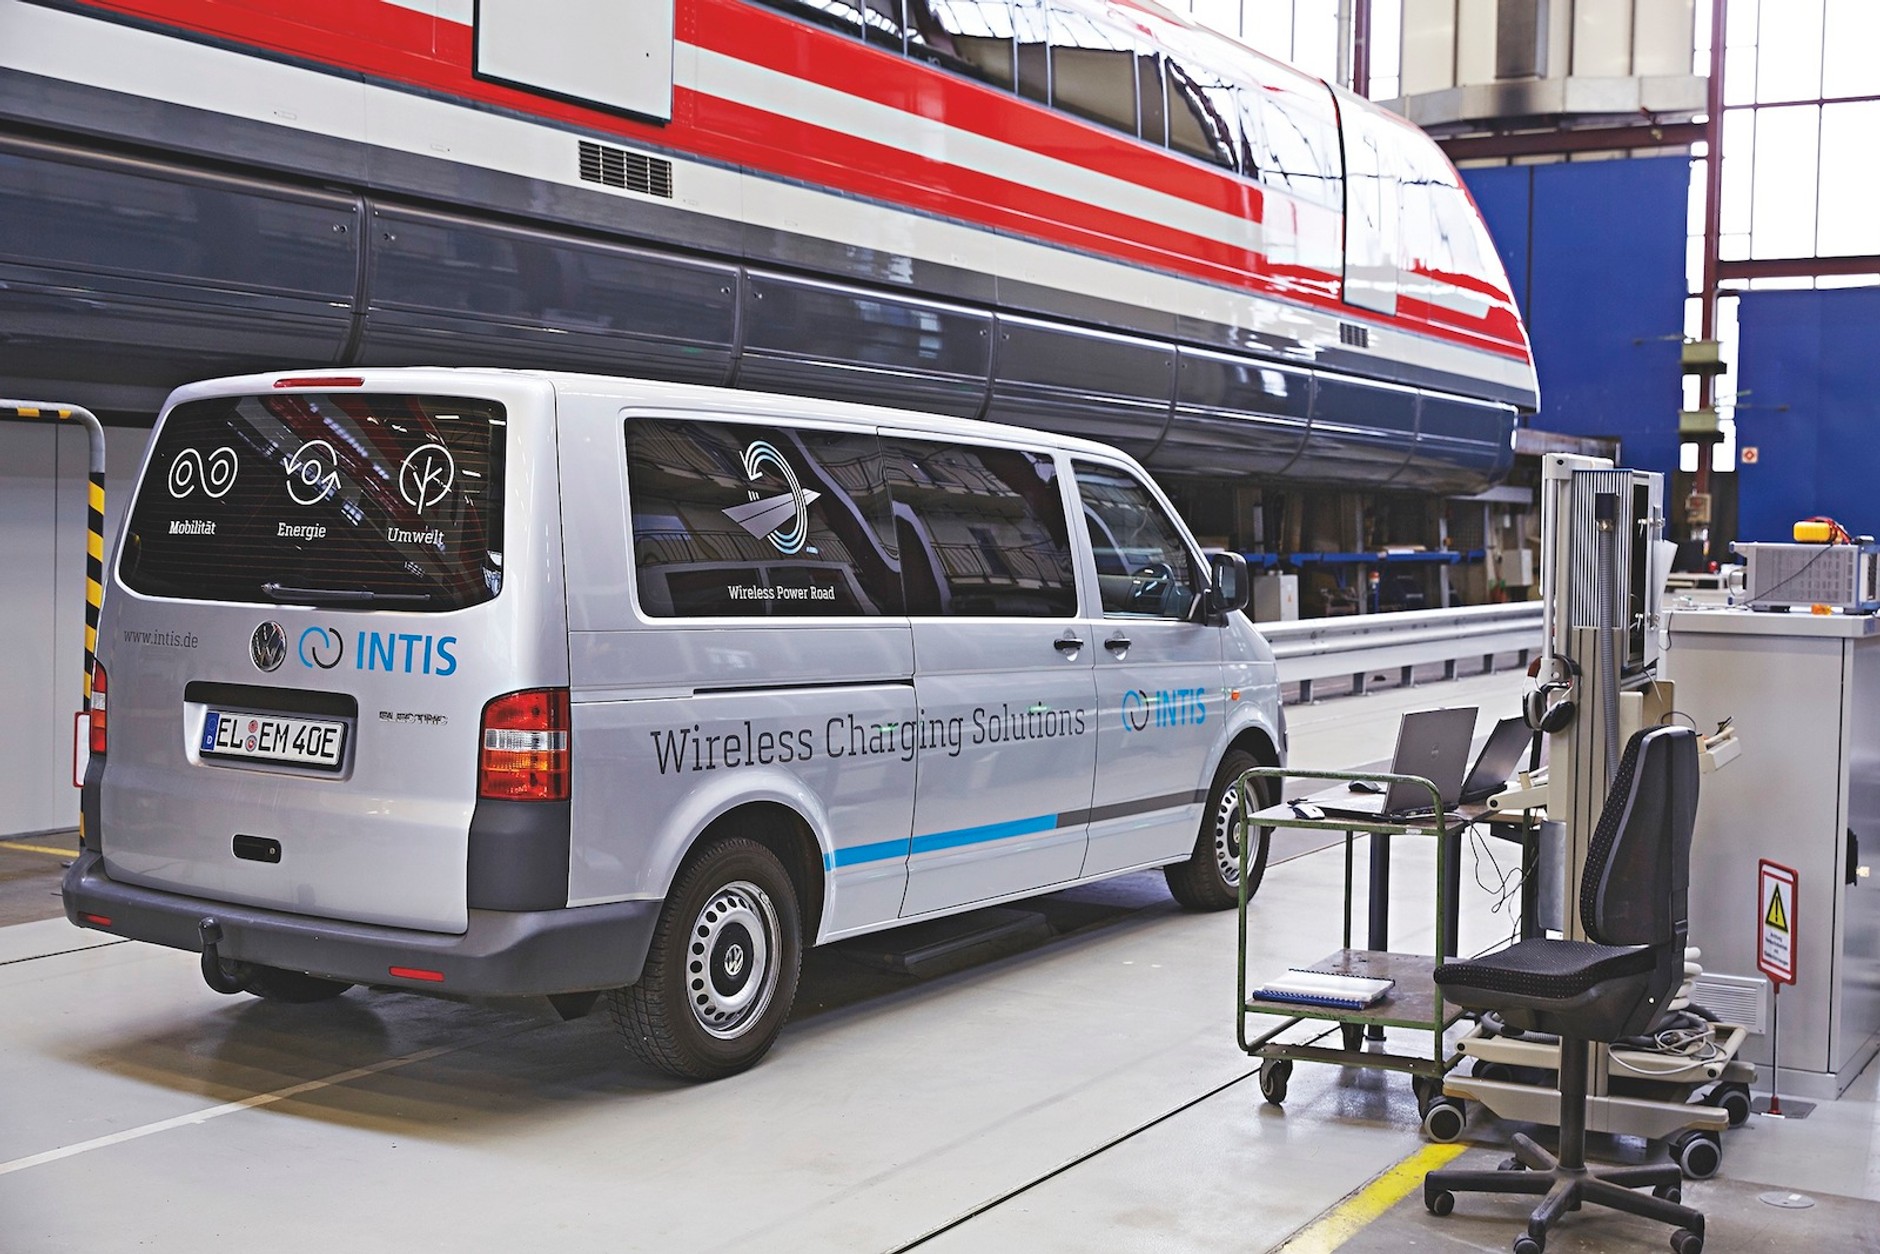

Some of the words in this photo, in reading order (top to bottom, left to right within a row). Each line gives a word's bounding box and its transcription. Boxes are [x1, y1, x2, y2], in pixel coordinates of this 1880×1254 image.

[169, 520, 217, 535] Mobilität
[277, 522, 327, 541] Energie
[387, 527, 445, 545] Umwelt
[728, 585, 775, 600] Wireless
[776, 585, 808, 600] Power
[810, 585, 835, 600] Road
[124, 629, 199, 649] www.intis.de
[356, 631, 458, 676] INTIS
[1156, 687, 1207, 727] INTIS
[206, 735, 213, 745] D
[650, 720, 813, 775] Wireless
[826, 713, 964, 762] Charging
[972, 701, 1085, 744] Solutions
